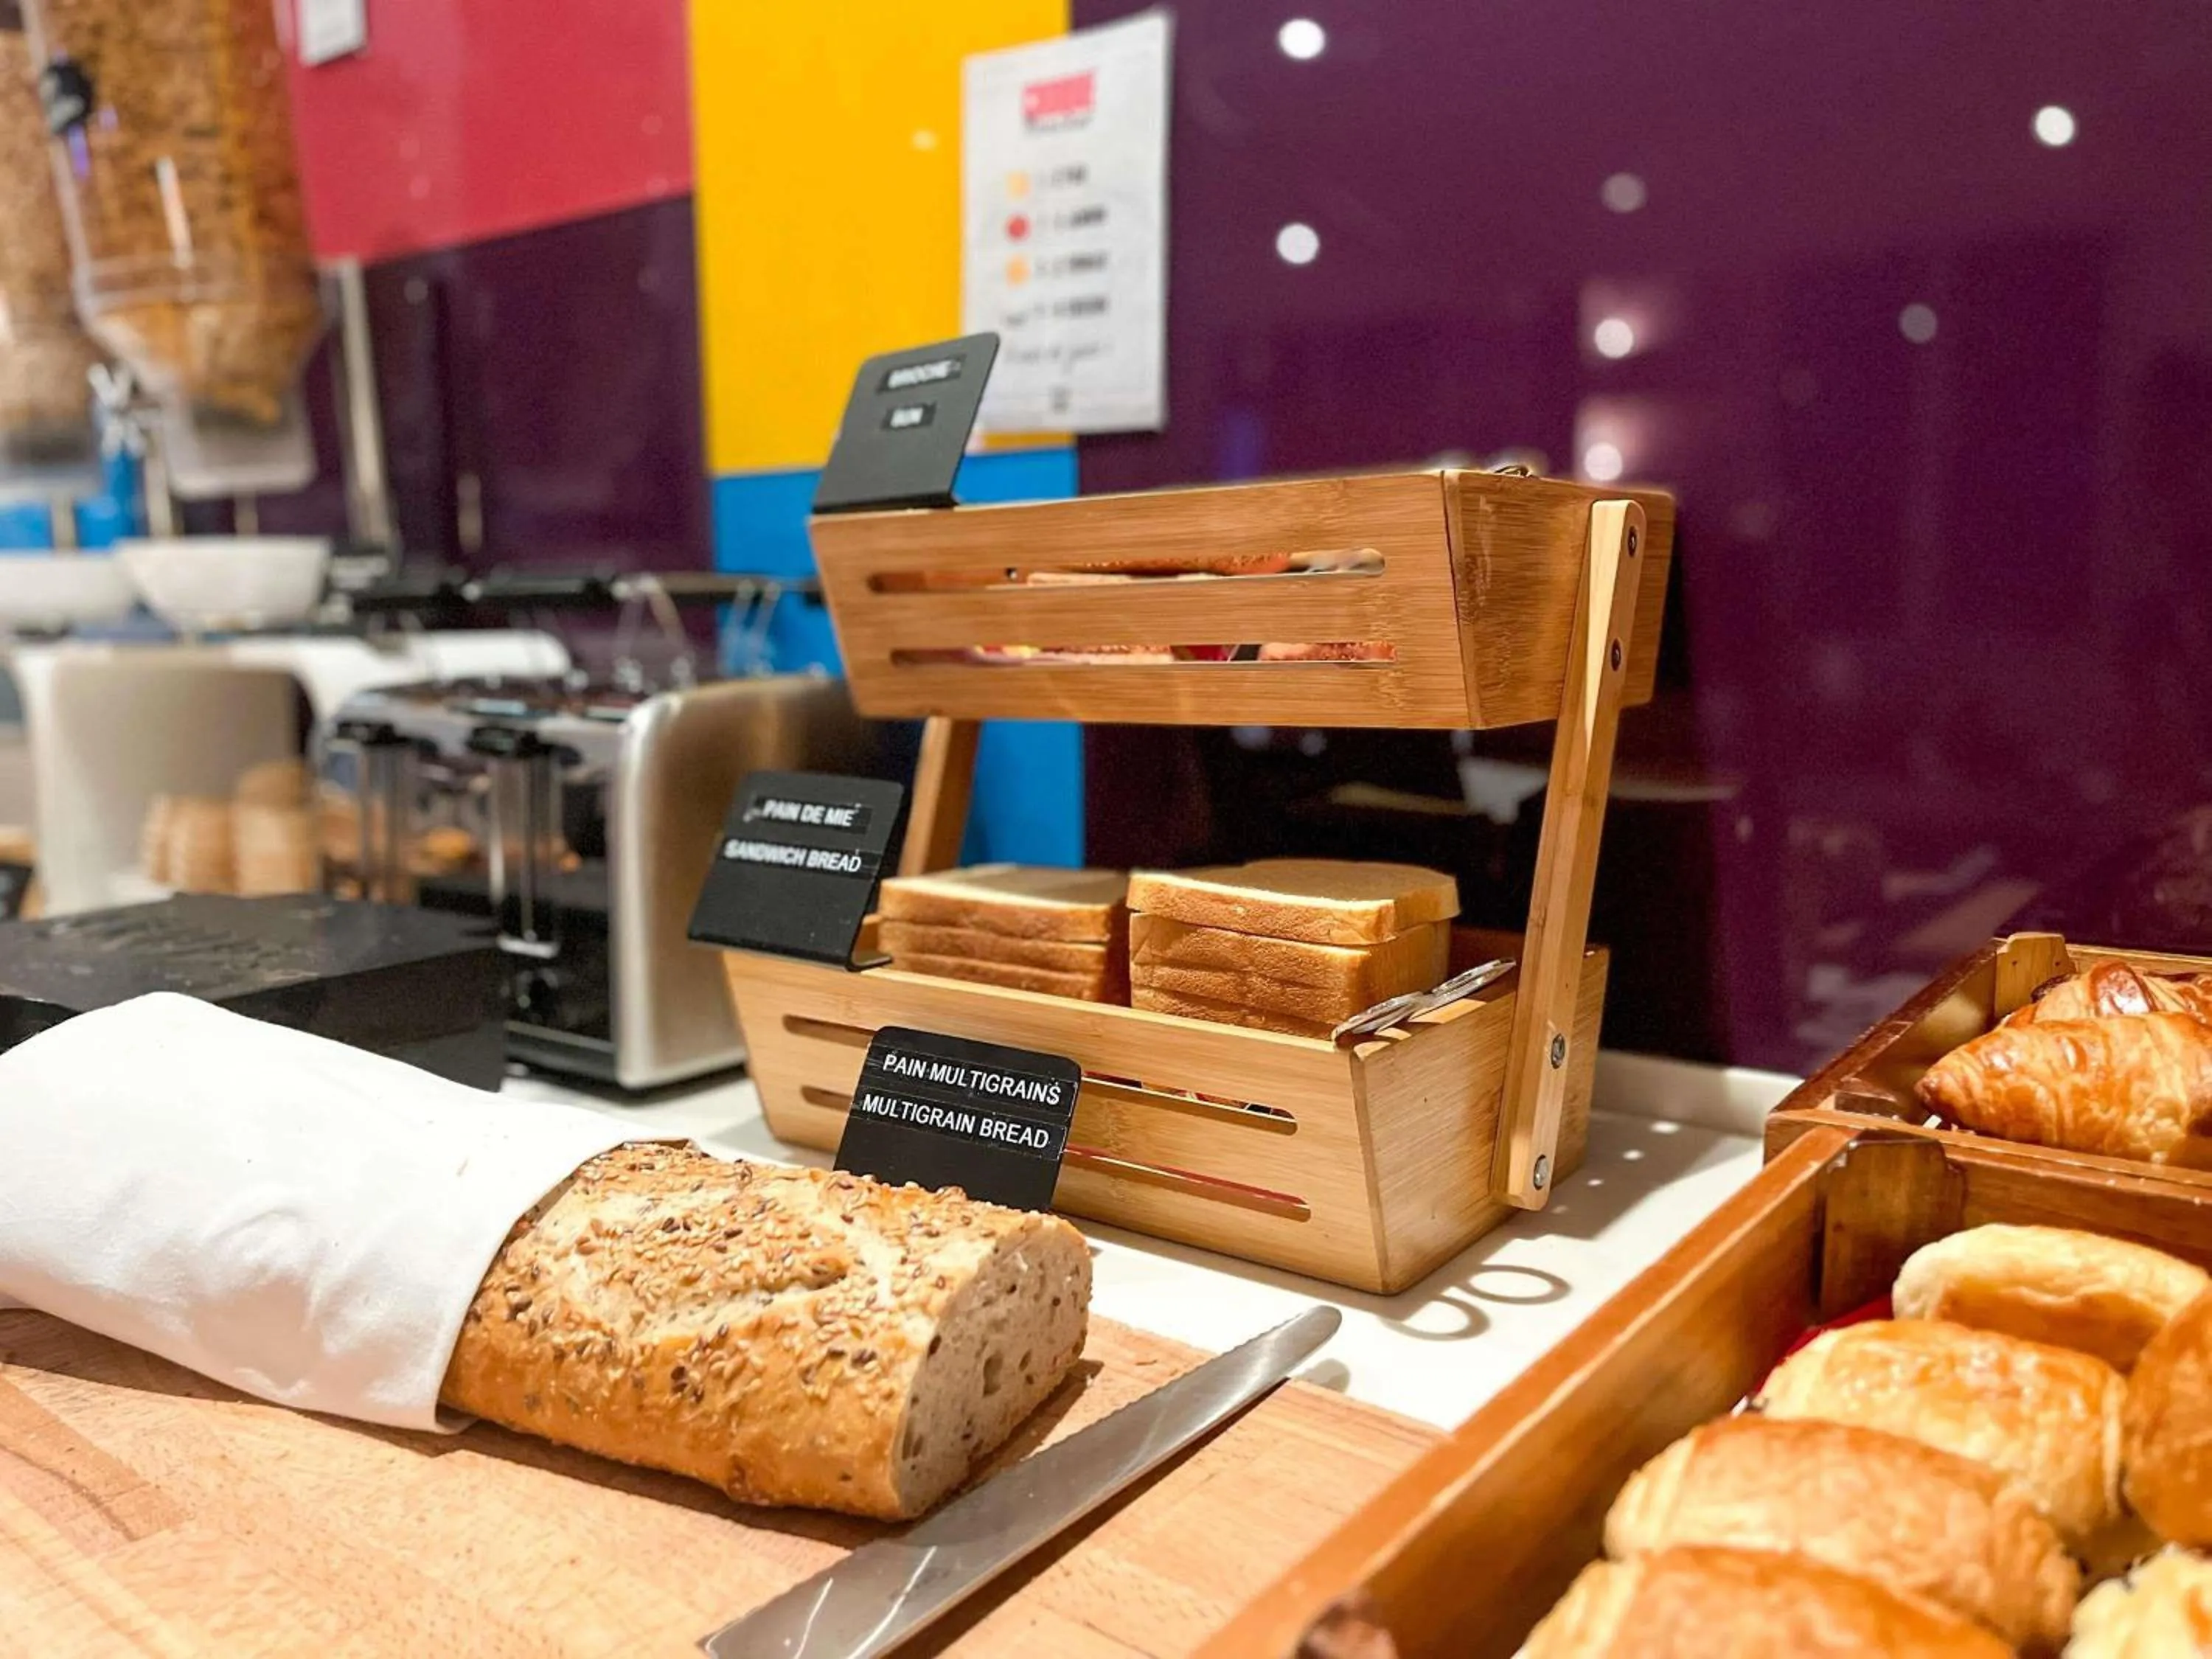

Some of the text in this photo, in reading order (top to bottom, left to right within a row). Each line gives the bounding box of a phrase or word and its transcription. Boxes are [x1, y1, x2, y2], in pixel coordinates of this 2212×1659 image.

[762, 799, 855, 827] PAIN DE MIE
[724, 838, 861, 872] SANDWICH BREAD
[883, 1054, 1061, 1105] PAIN MULTIGRAINS
[862, 1093, 1049, 1149] MULTIGRAIN BREAD
